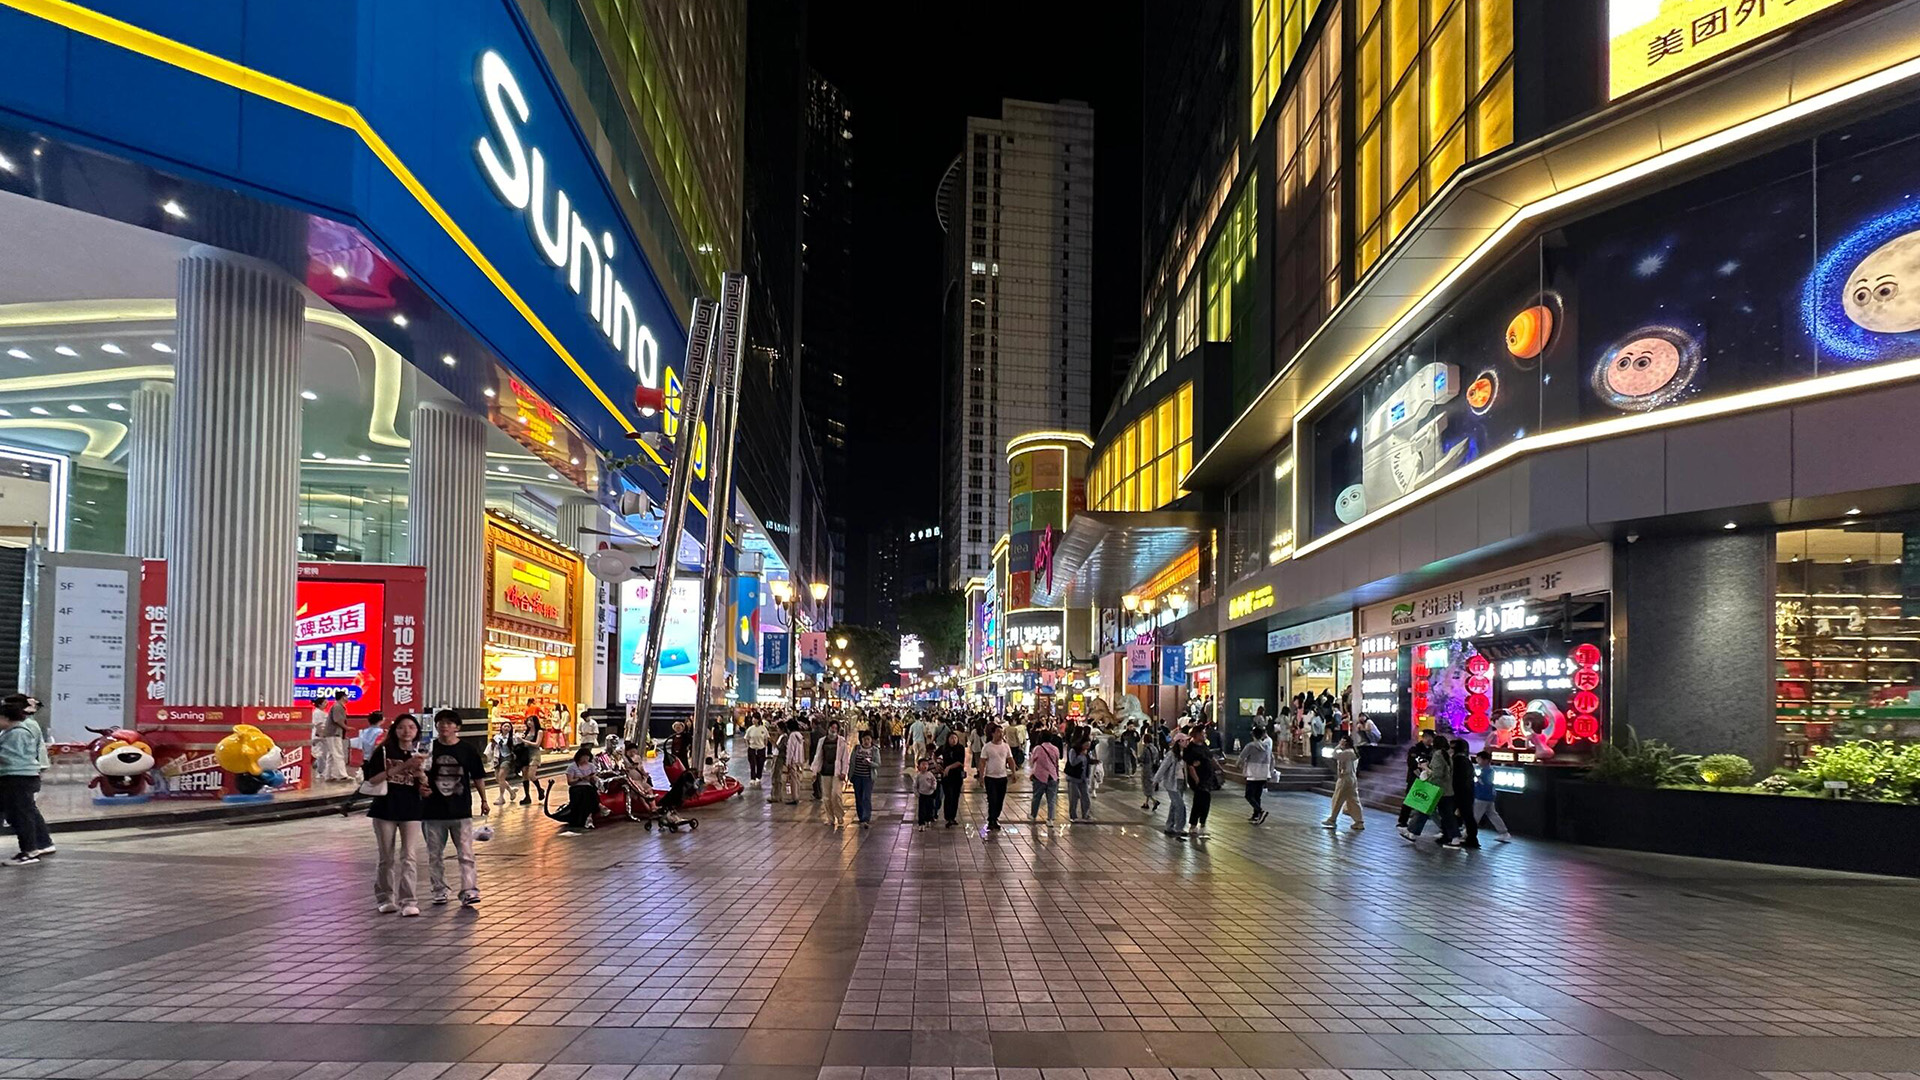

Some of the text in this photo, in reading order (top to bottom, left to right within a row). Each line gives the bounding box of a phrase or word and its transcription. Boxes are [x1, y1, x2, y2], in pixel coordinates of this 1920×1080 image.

[1647, 0, 1796, 67] 美团外
[60, 582, 74, 591] 5F
[58, 607, 74, 616] 4F
[295, 608, 360, 638] 碑总店
[58, 636, 73, 645] 3F
[57, 664, 72, 672] 2F
[56, 693, 72, 701] 1F
[169, 711, 205, 722] Suning
[266, 711, 290, 722] Suning
